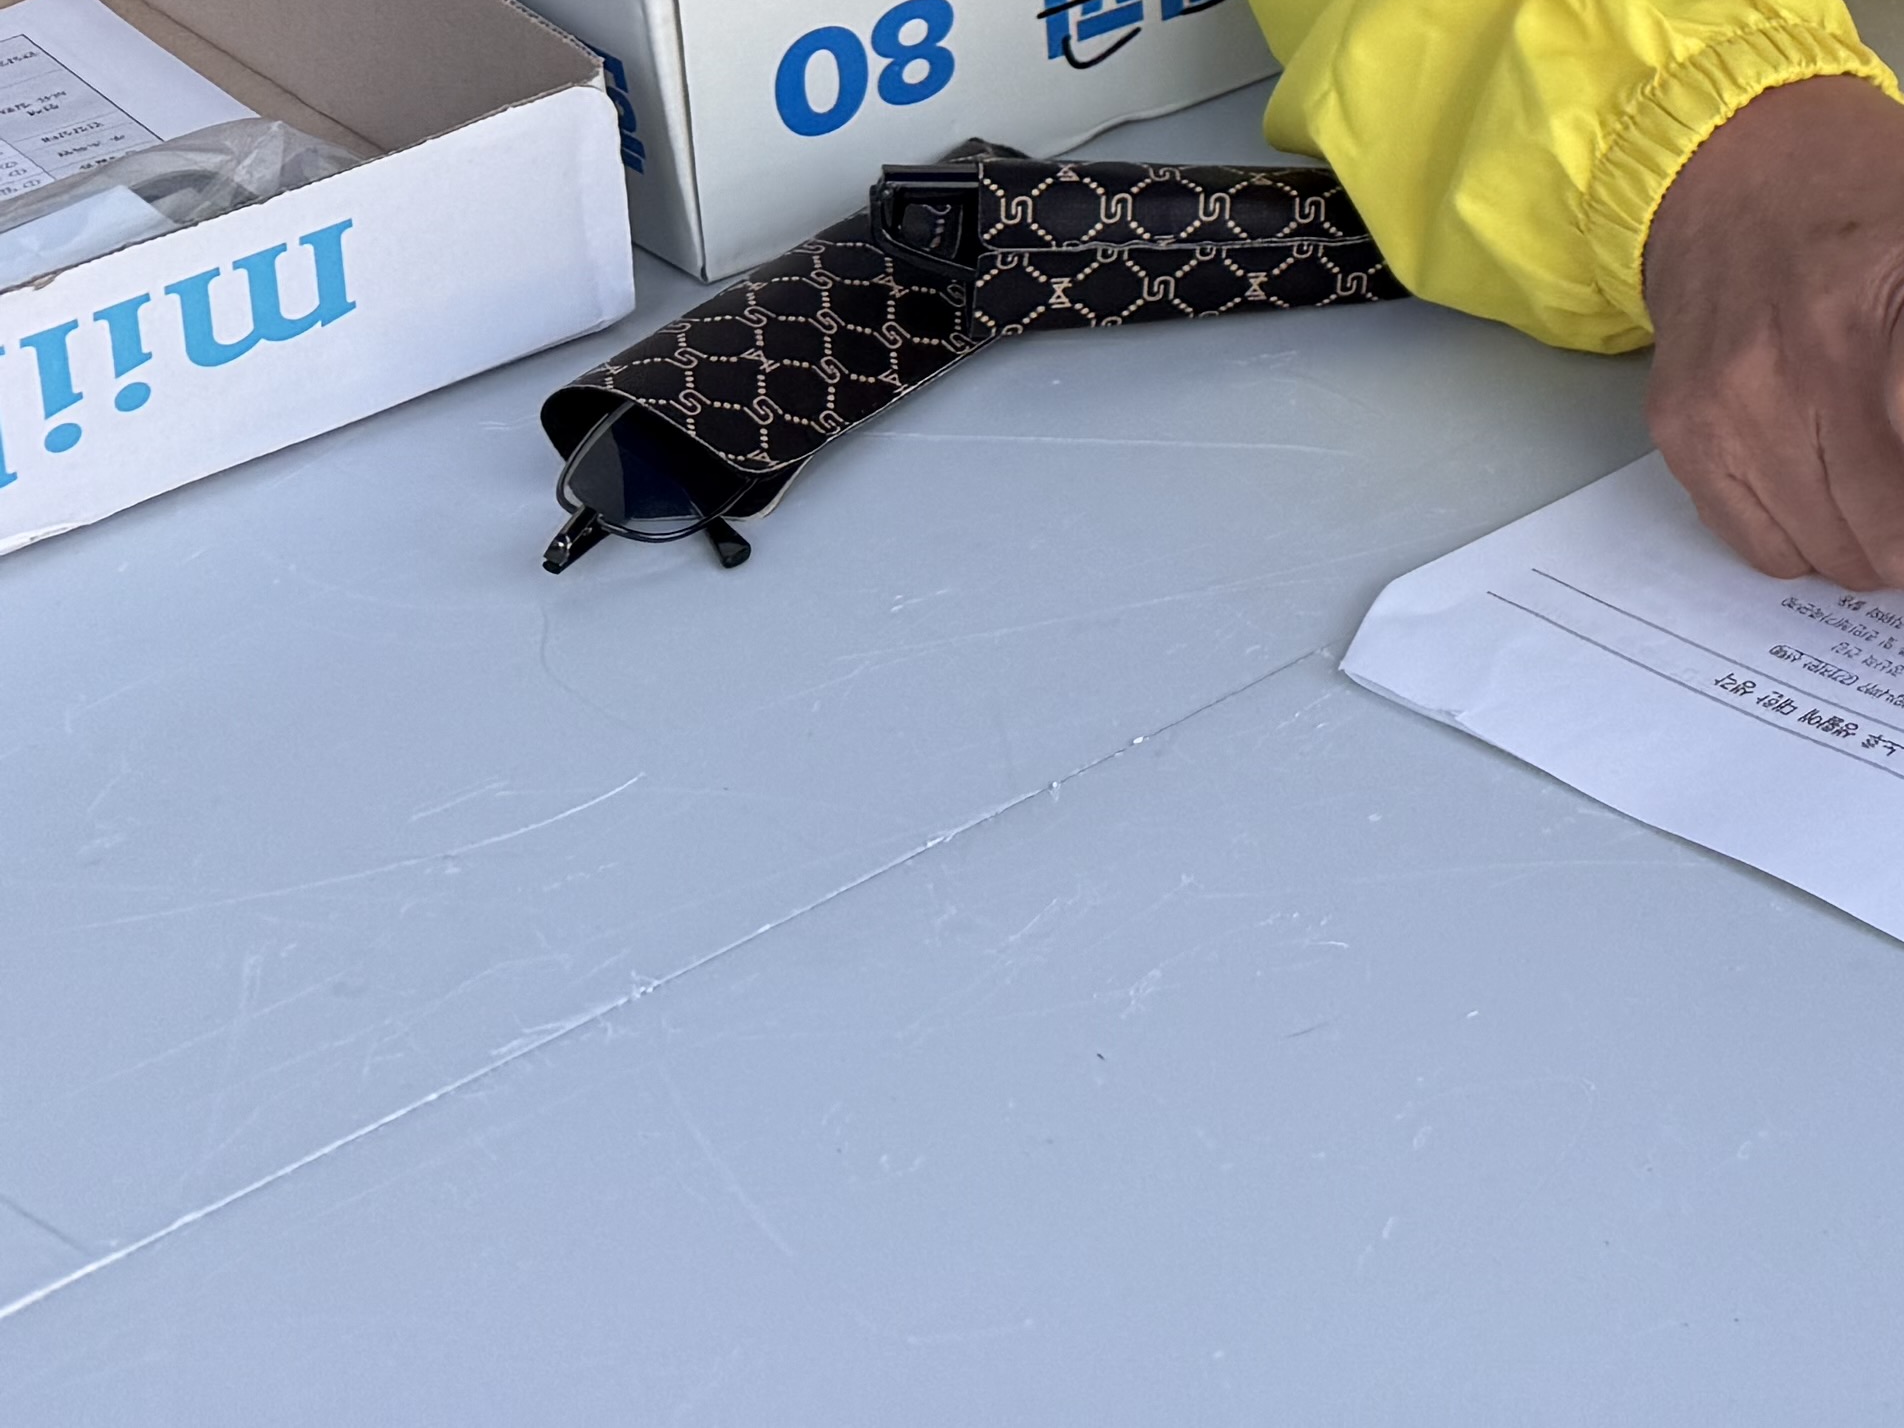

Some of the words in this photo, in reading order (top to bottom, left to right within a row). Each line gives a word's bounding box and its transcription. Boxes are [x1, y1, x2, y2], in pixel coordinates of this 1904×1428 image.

[0, 217, 357, 489] mii
[1713, 671, 1757, 697] 생각
[1755, 690, 1798, 716] 대한
[1796, 707, 1859, 739] 생활에
